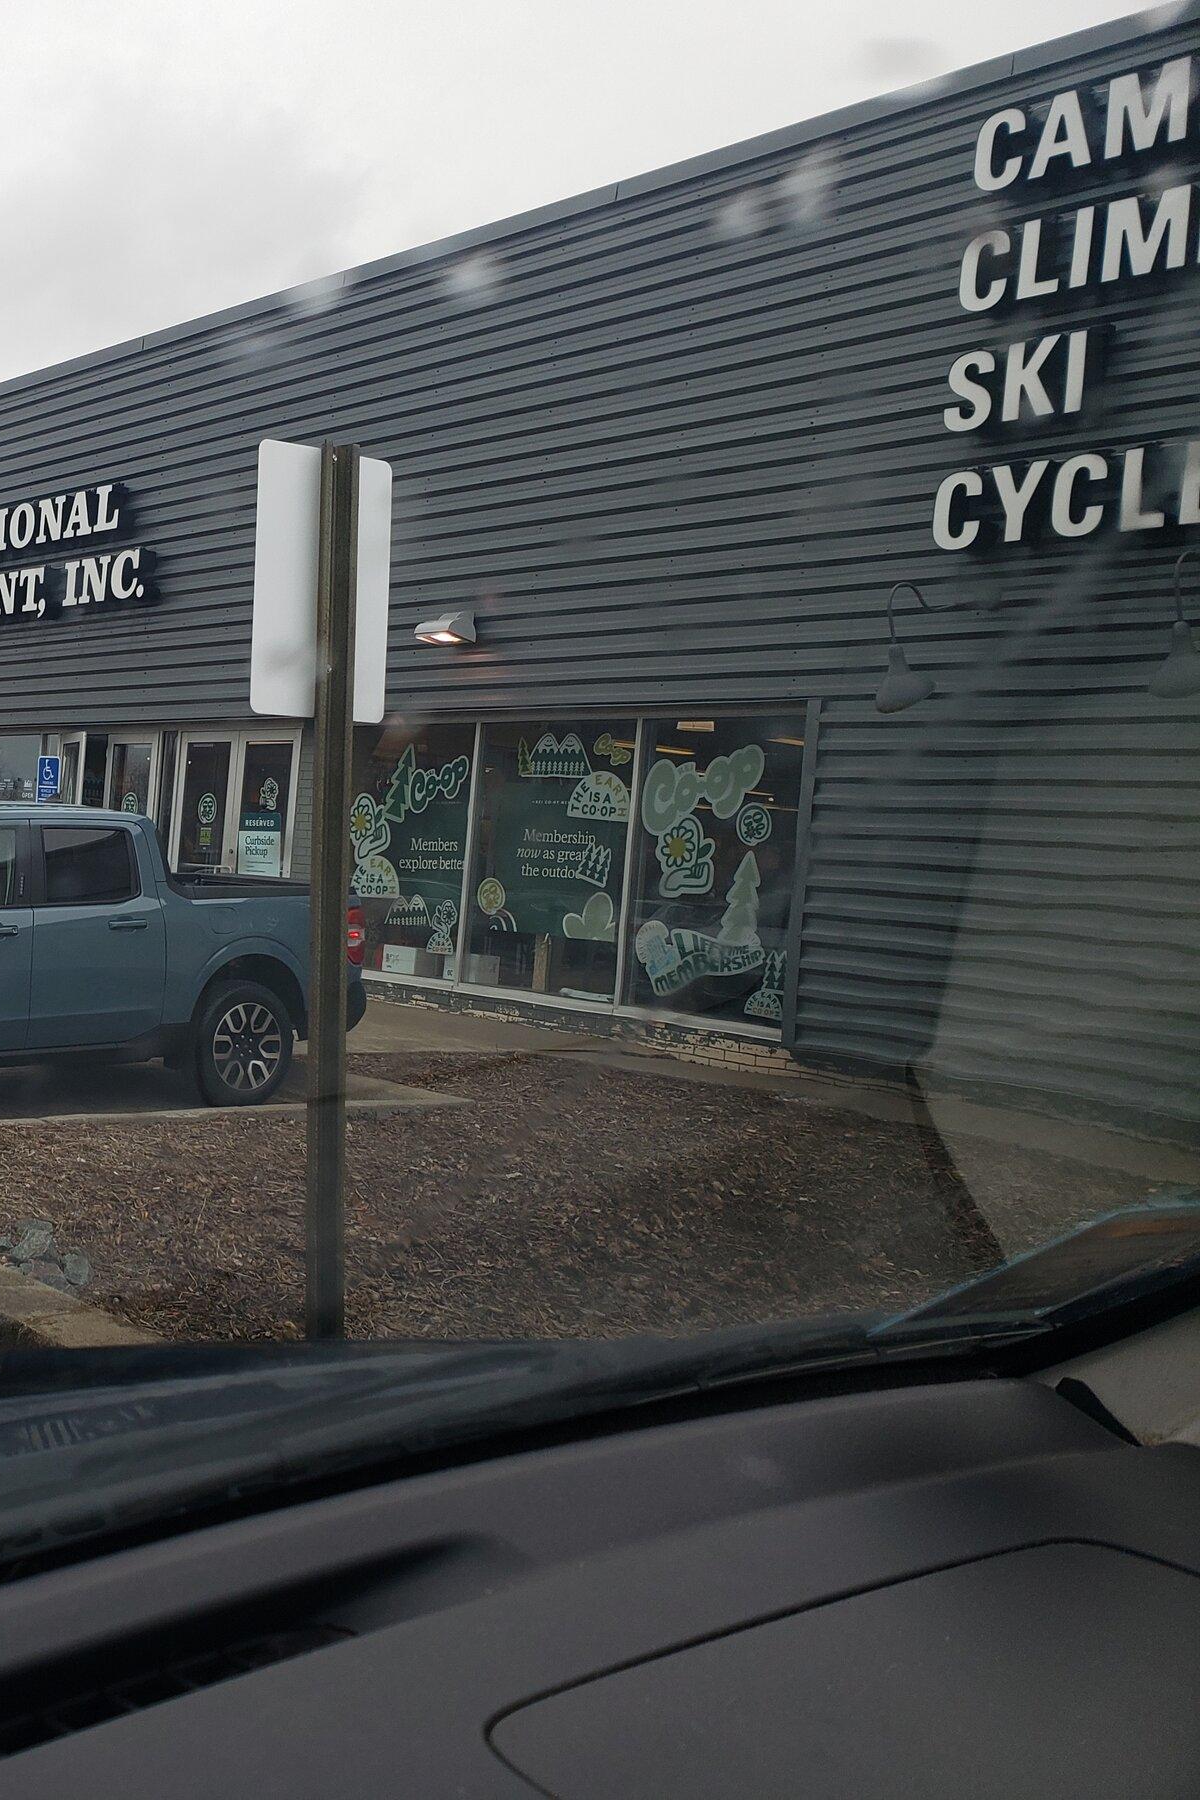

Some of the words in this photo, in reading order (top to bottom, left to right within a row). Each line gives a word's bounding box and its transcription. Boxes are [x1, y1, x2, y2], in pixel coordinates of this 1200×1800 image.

[958, 183, 1200, 312] CLIM
[943, 329, 1088, 433] SKI
[61, 547, 145, 607] INC.
[570, 782, 589, 812] THE
[595, 774, 628, 817] EARTH
[589, 791, 600, 803] IS
[603, 793, 612, 804] A
[244, 819, 275, 828] RESERVED
[245, 835, 275, 846] Curbside
[410, 837, 458, 852] Members
[523, 829, 596, 845] Membership
[245, 845, 268, 858] Pickup
[516, 847, 541, 858] now
[543, 850, 555, 860] as
[557, 850, 588, 863] great
[399, 856, 437, 872] explore
[521, 863, 539, 877] the
[351, 865, 367, 891] THE
[370, 858, 397, 895] EARTH
[366, 873, 375, 883] IS
[375, 873, 384, 884] A
